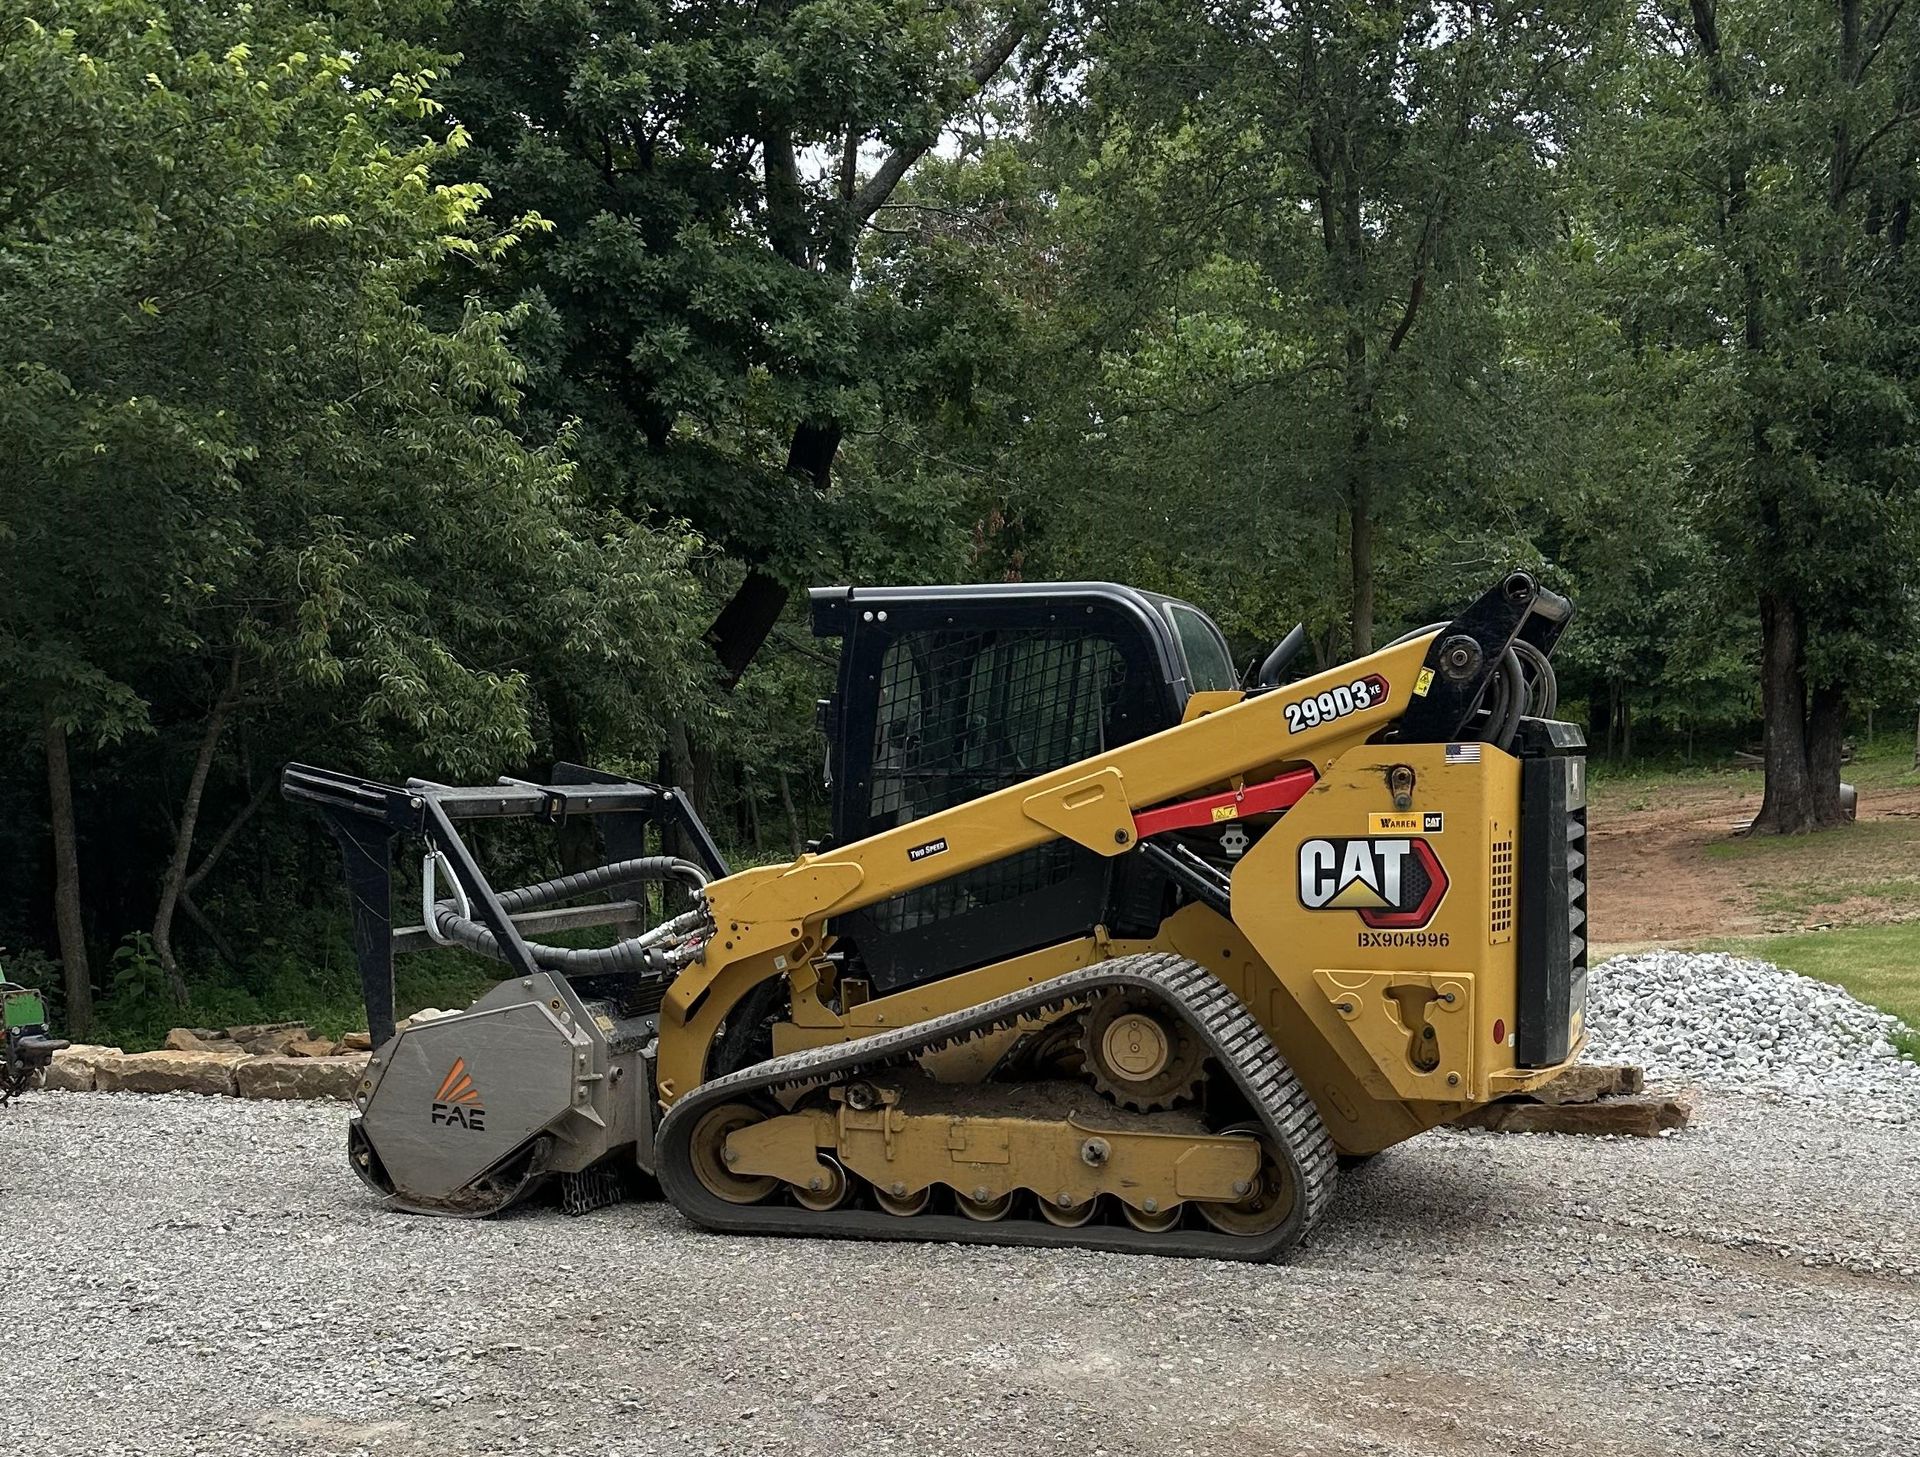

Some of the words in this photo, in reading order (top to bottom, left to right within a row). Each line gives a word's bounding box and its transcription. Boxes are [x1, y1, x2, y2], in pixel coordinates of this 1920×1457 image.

[1284, 680, 1372, 735] 299D3
[1369, 684, 1382, 696] XE
[1425, 817, 1441, 828] CAT
[1300, 840, 1411, 907] CAT
[1357, 933, 1450, 948] BX904996
[431, 1102, 486, 1132] FAE
